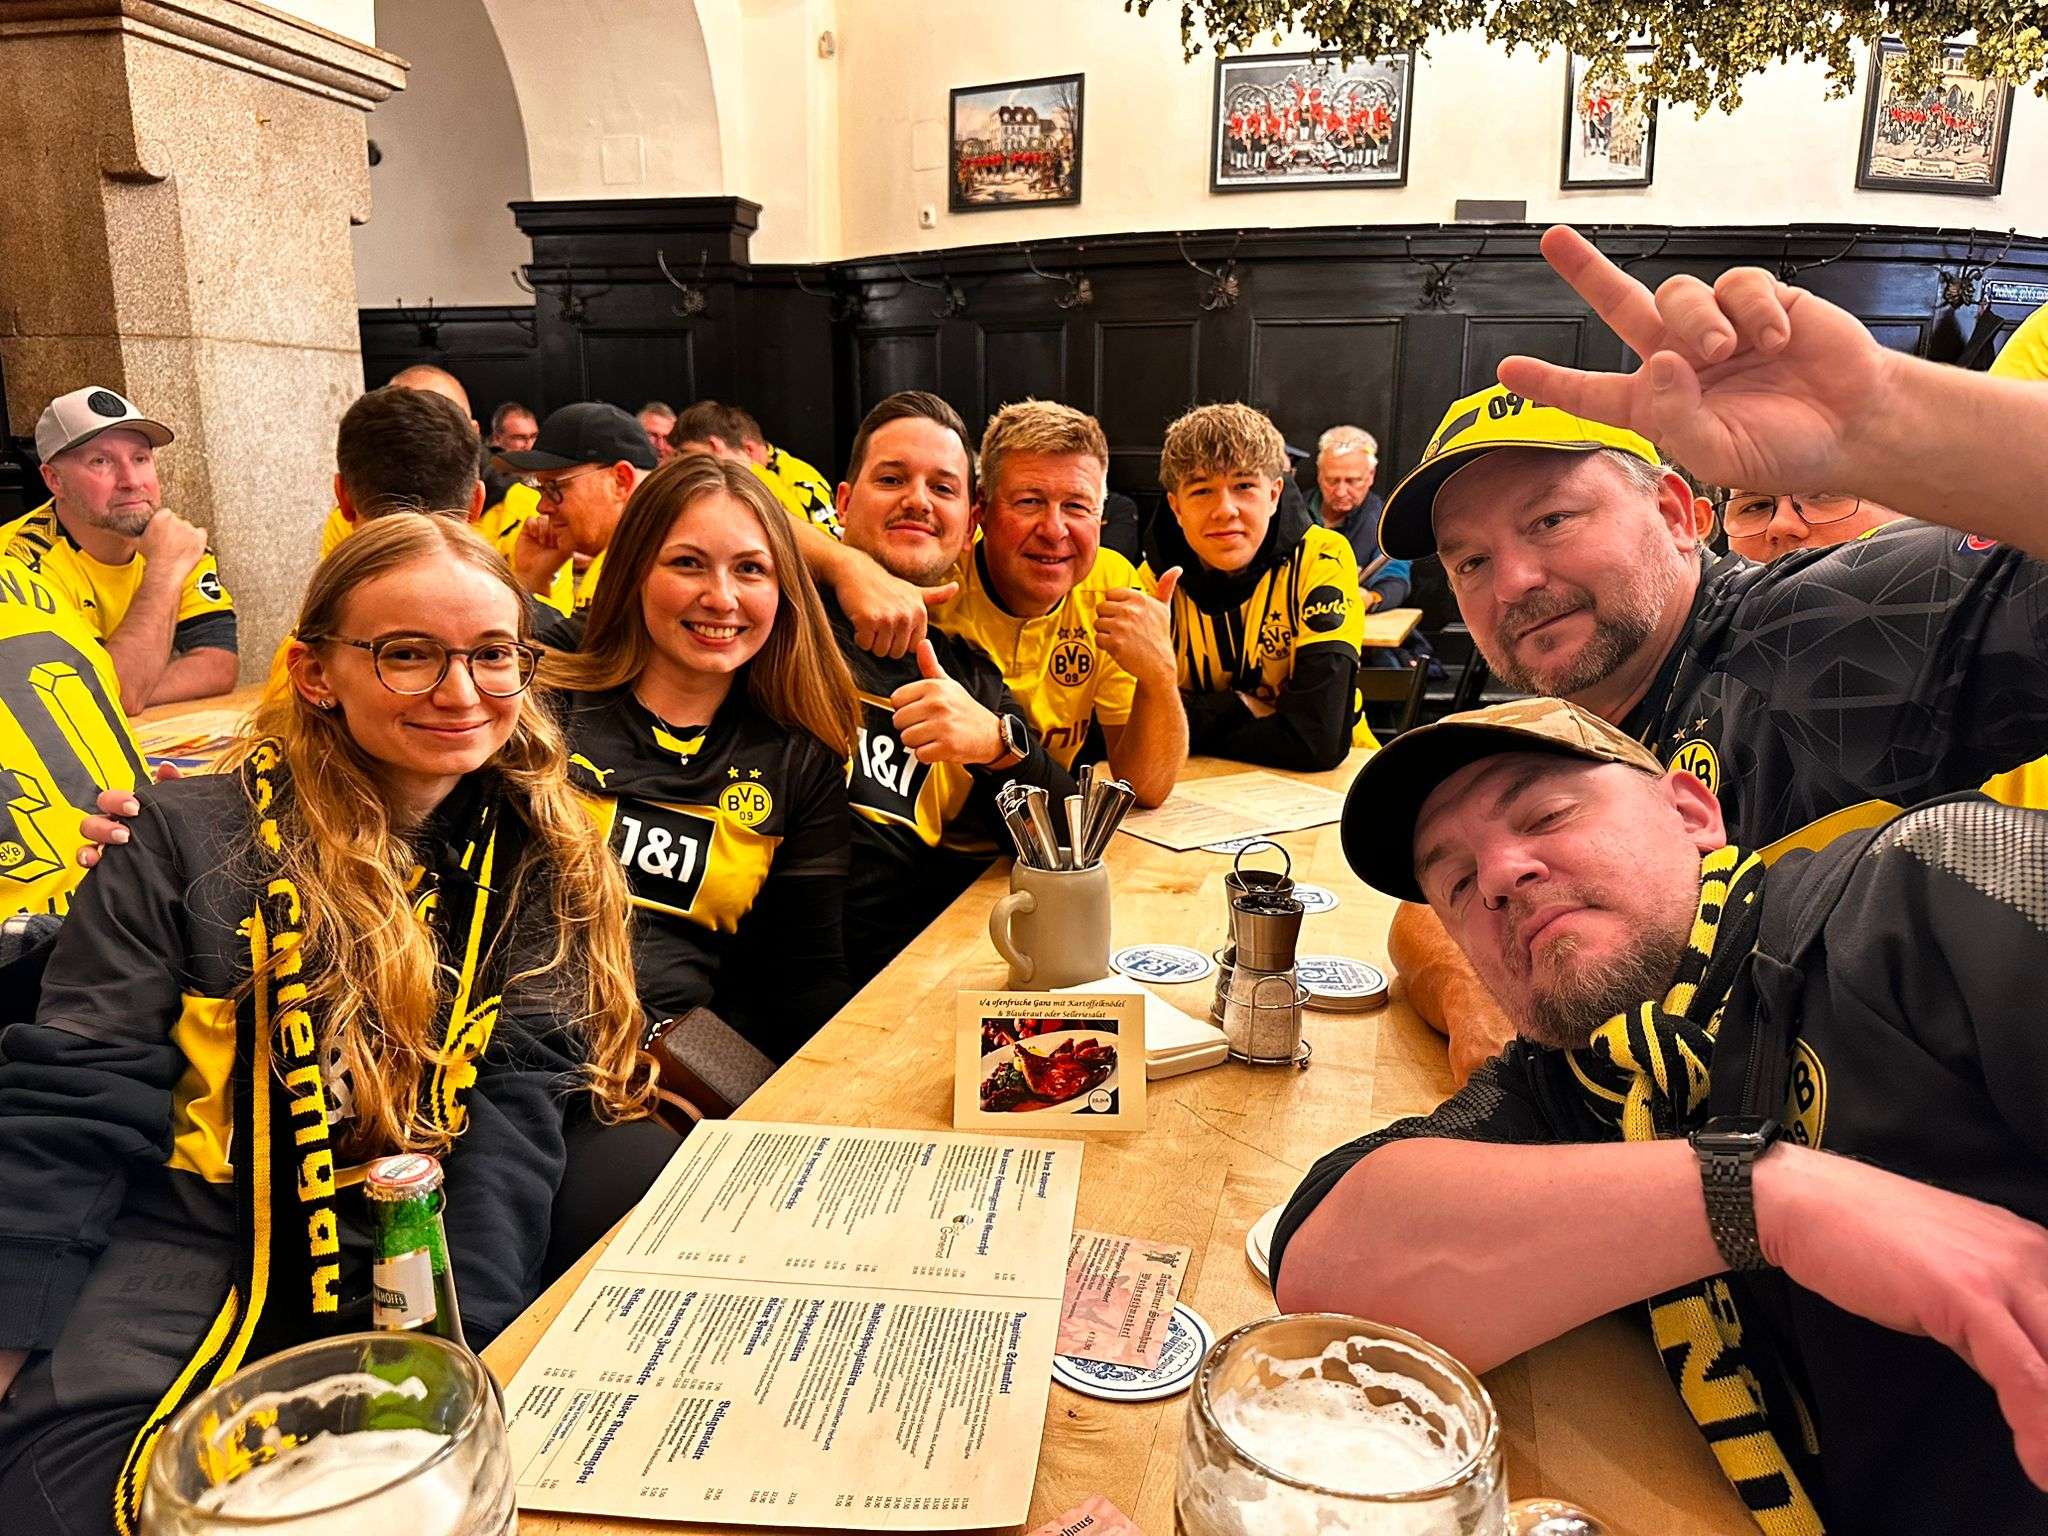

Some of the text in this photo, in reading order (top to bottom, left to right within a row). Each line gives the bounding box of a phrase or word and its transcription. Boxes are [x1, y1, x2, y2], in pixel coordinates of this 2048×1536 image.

[1488, 392, 1524, 419] 09
[1055, 645, 1091, 676] BVB
[1065, 673, 1078, 684] 09
[728, 787, 765, 812] BVB
[739, 811, 753, 821] 09
[620, 816, 698, 883] 1&1
[992, 998, 1032, 1008] ofenfrische
[1033, 999, 1052, 1008] Gans
[1005, 1010, 1043, 1018] Blaukraut
[1044, 1010, 1061, 1018] oder
[1121, 1273, 1151, 1338] Wochenschmankerl
[1137, 1273, 1172, 1353] Augustiner Stammhaus
[744, 1320, 769, 1355] Portionen
[1009, 1312, 1027, 1350] Augustiner
[1000, 1352, 1017, 1394] Schmankerl
[577, 1394, 639, 1483] Unser Kuchenangebot
